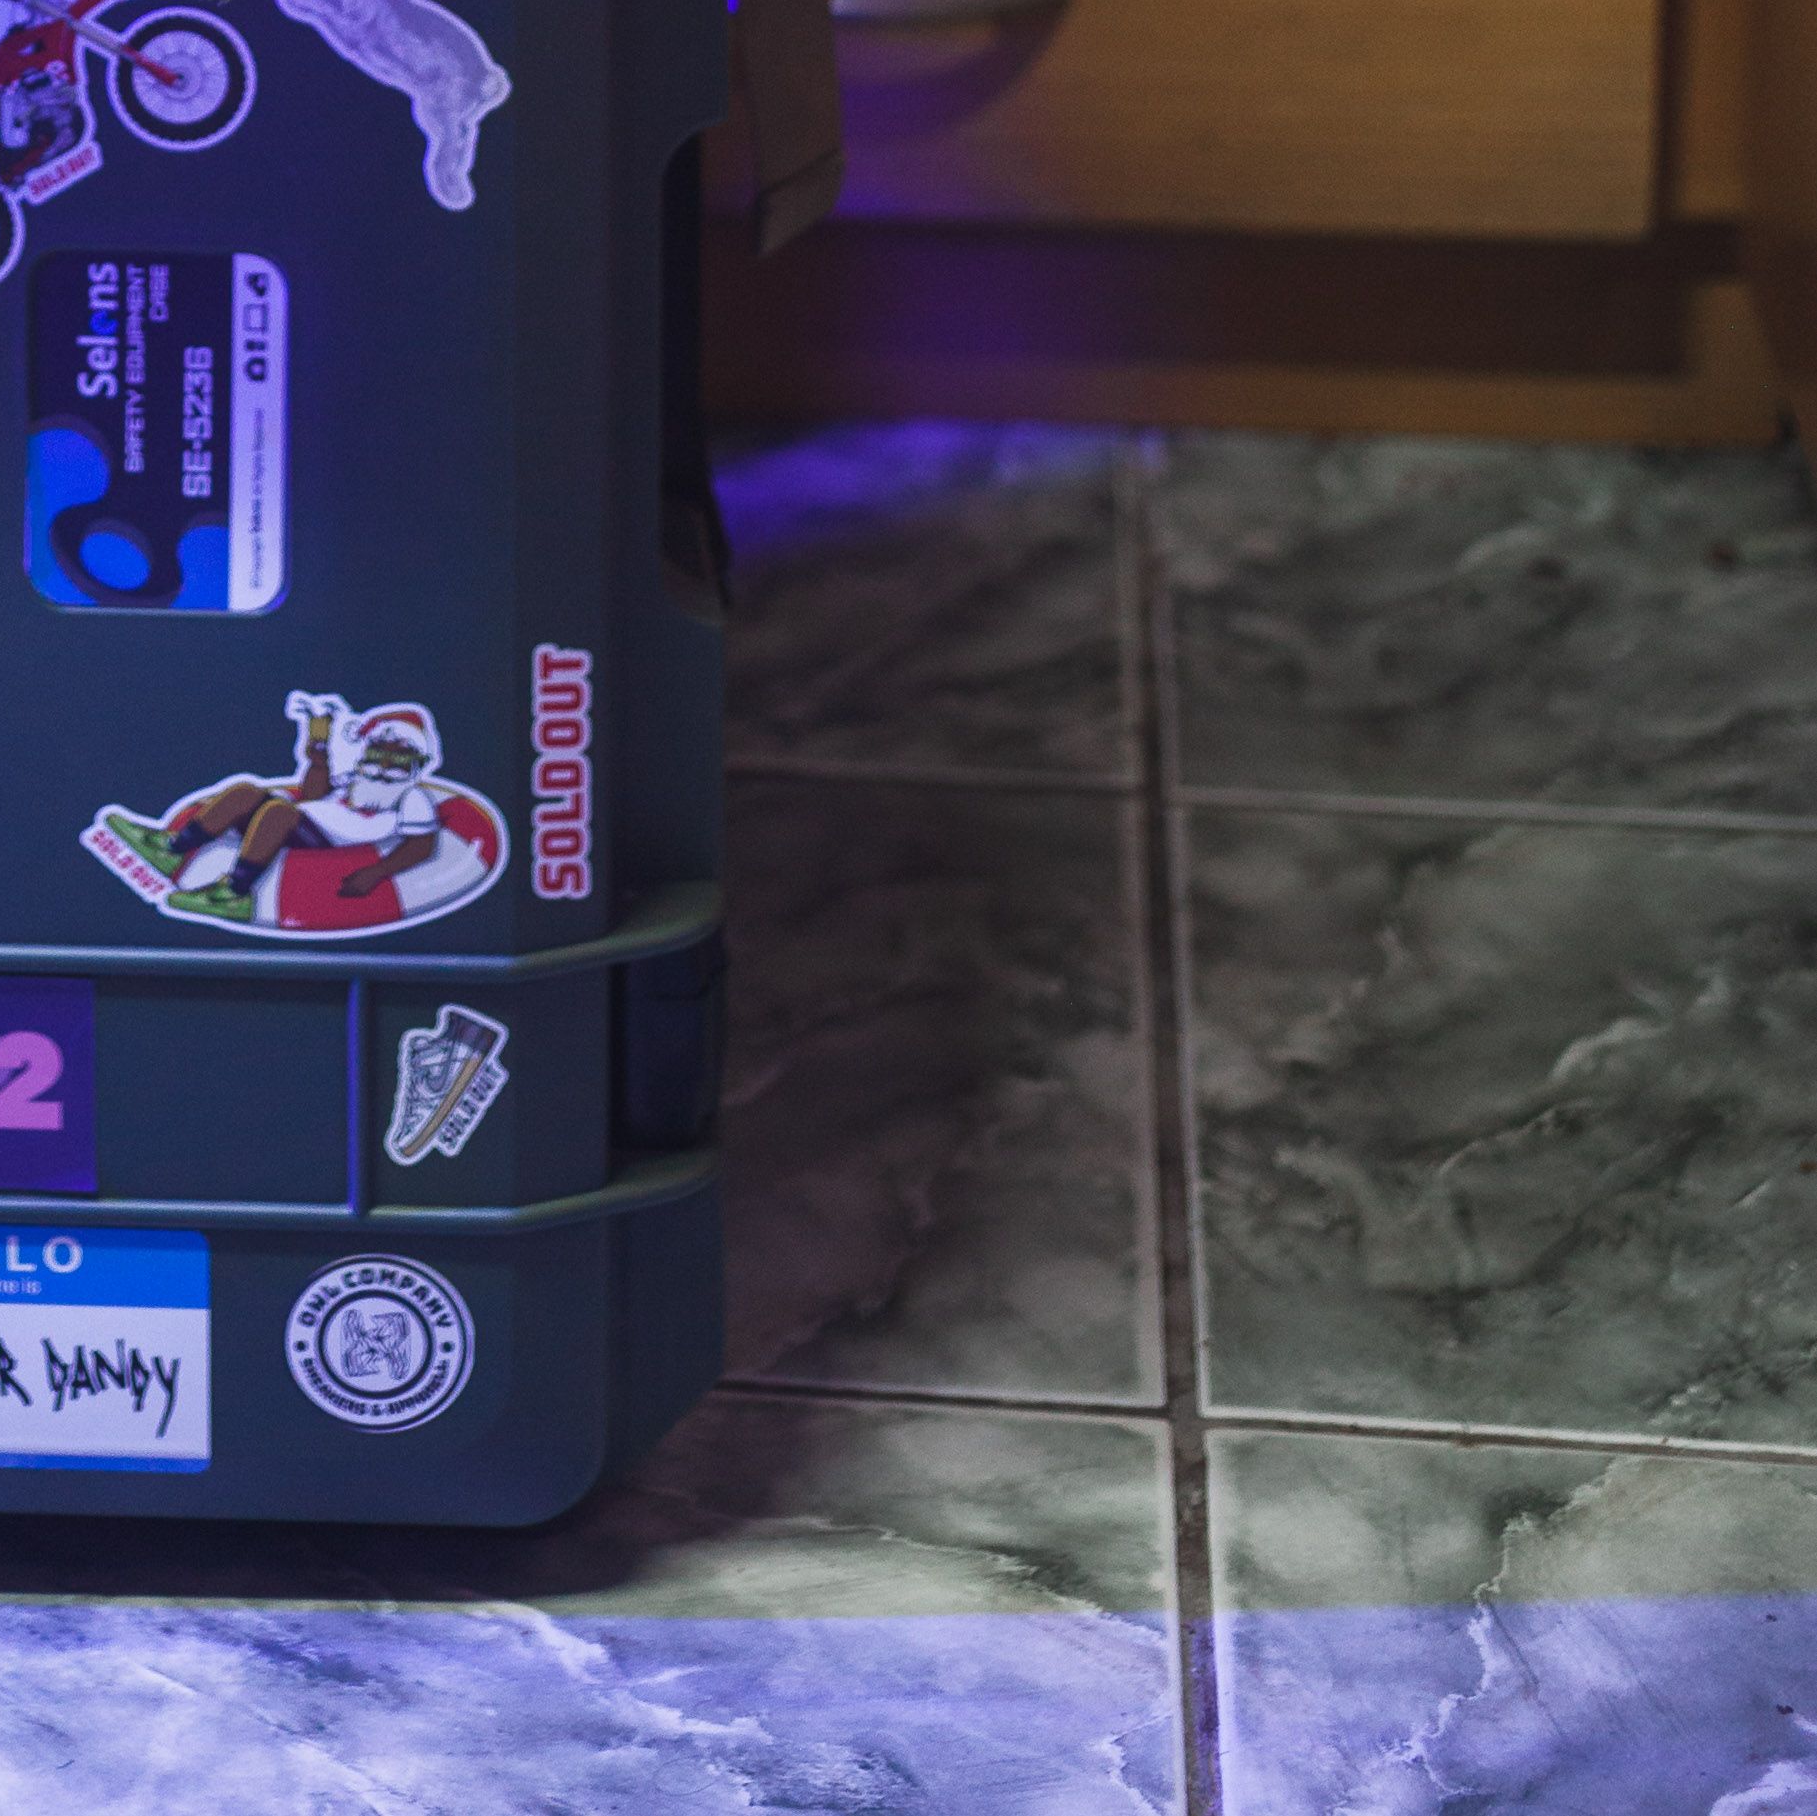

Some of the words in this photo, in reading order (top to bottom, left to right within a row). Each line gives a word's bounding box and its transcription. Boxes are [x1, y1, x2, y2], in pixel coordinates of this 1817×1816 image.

[124, 263, 147, 385] EQUIPMENT
[149, 263, 170, 323] CASE
[124, 389, 146, 474] SAFETY
[541, 650, 584, 748] OUT
[541, 759, 584, 893] SOLD
[21, 1277, 42, 1296] is
